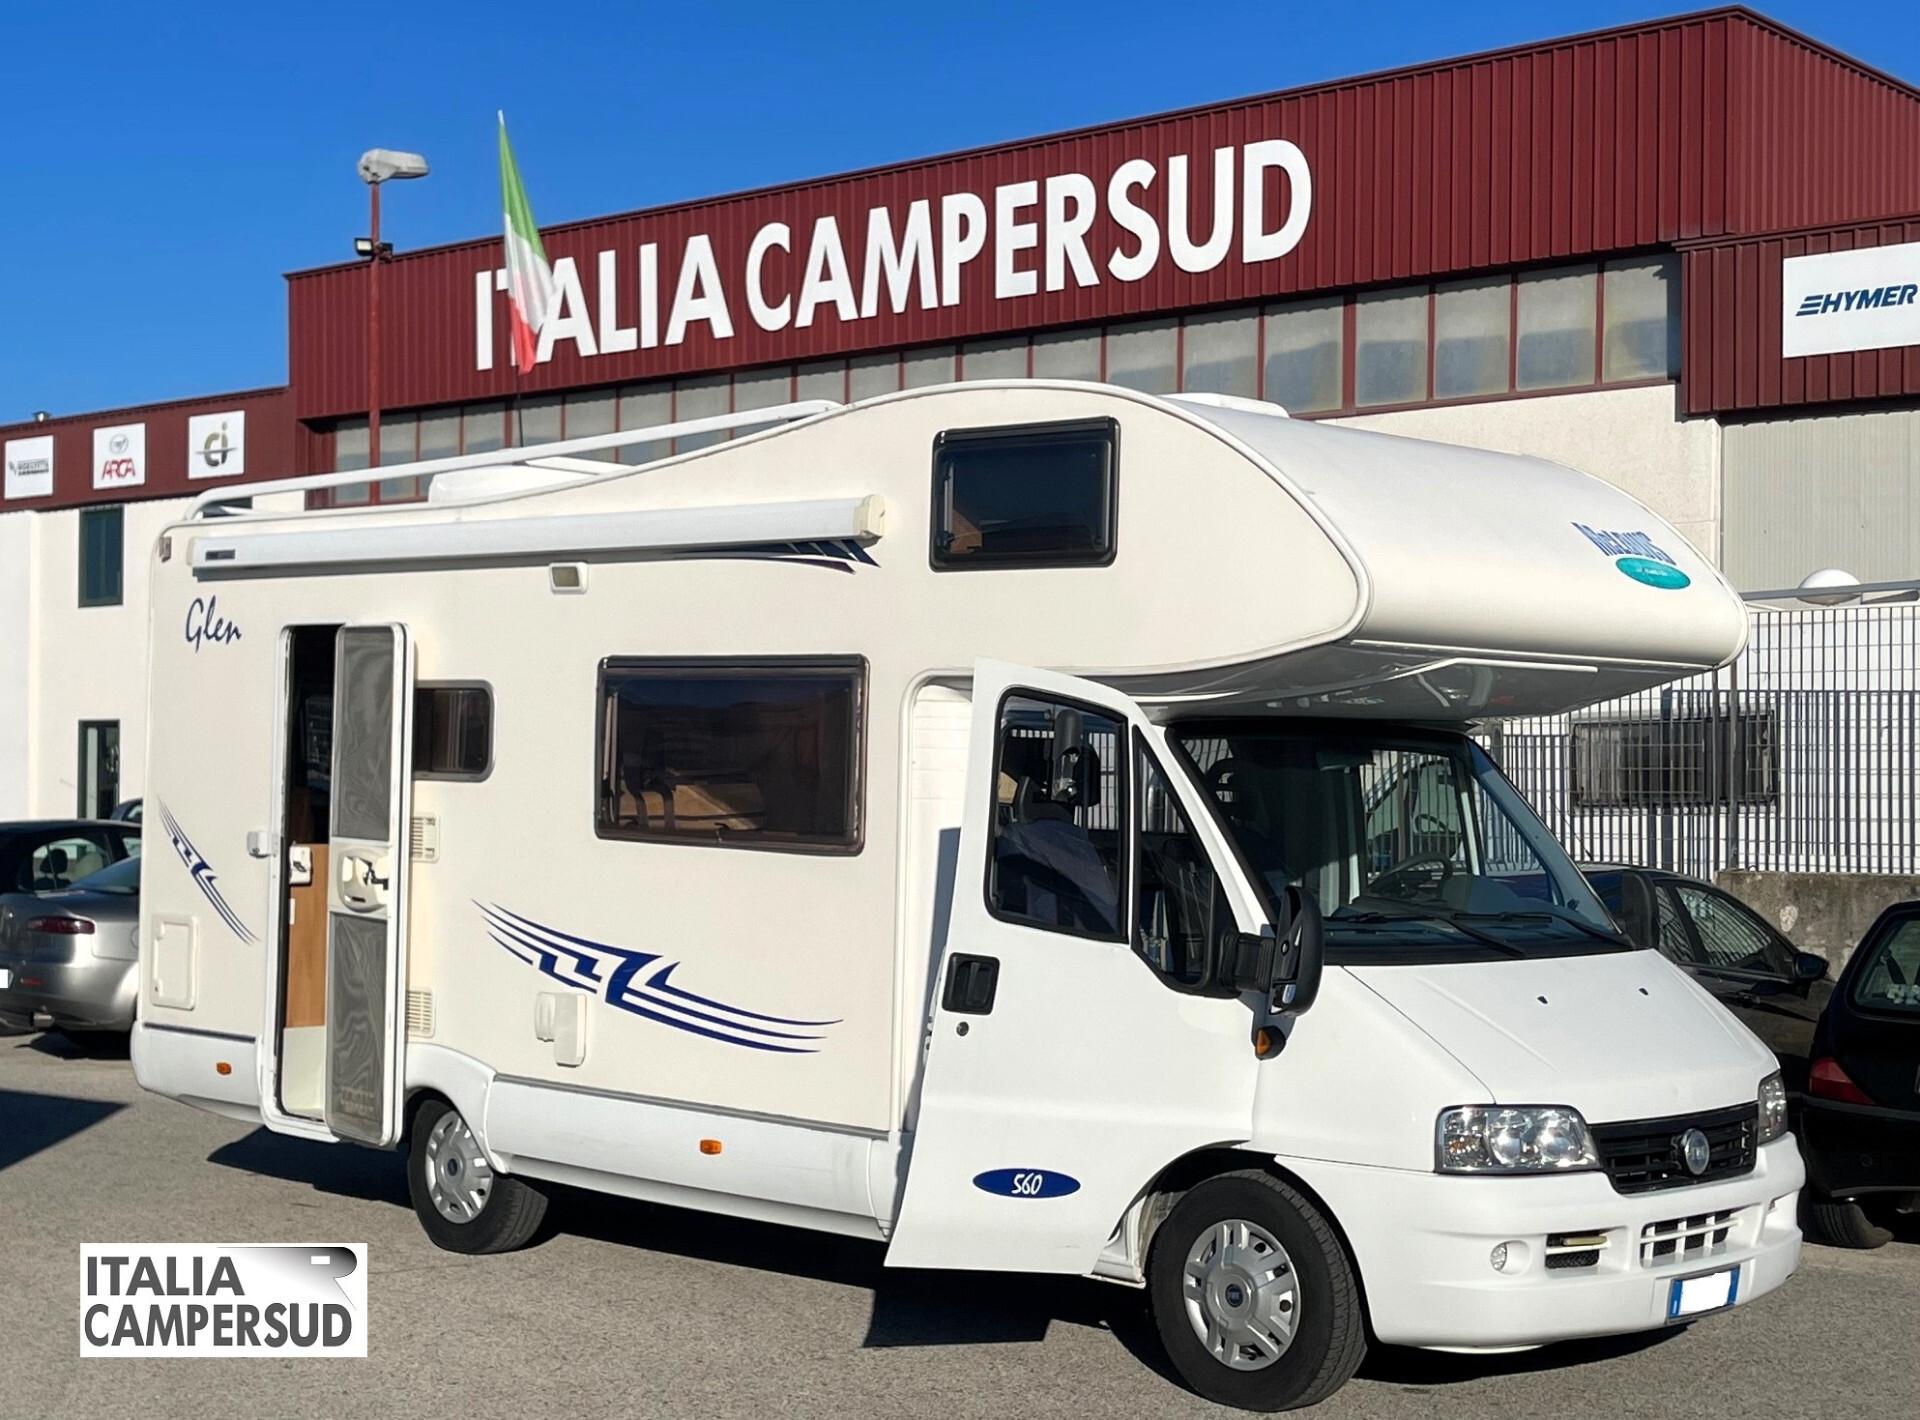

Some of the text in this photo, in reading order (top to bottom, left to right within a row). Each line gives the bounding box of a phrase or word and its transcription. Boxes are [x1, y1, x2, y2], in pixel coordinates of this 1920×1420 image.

[476, 139, 1313, 372] IALIA CAMPERSUD
[1820, 284, 1918, 314] HYMER
[101, 457, 136, 480] ARCA
[186, 594, 242, 653] Glen
[1010, 1172, 1043, 1195] 560
